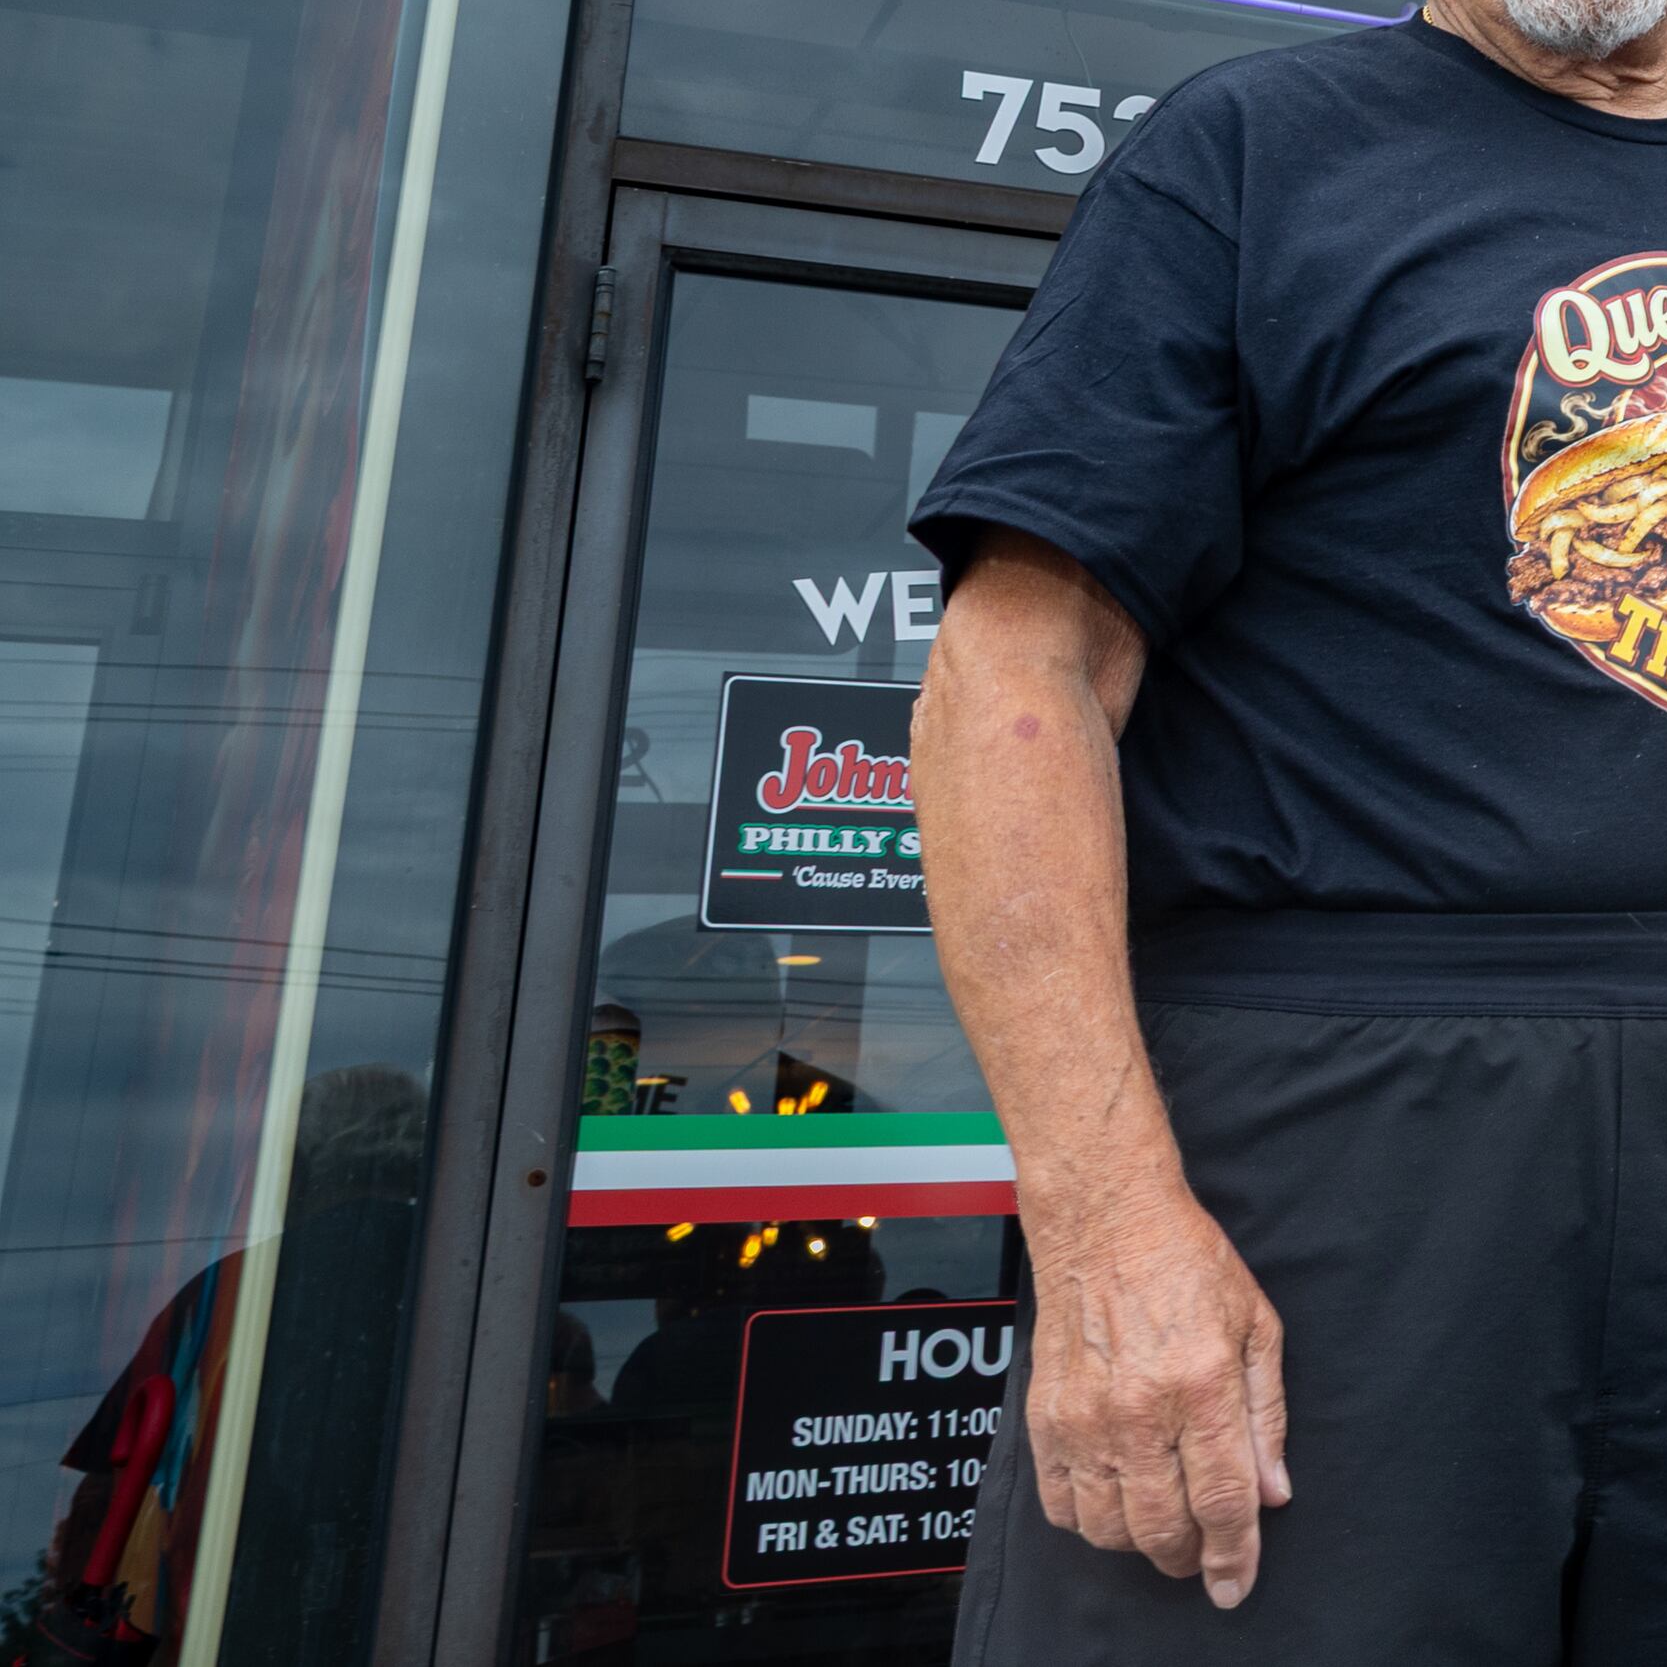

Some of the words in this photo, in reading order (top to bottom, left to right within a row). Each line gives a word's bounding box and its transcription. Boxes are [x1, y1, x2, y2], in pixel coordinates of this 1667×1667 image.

[740, 825, 892, 856] PHILLY
[868, 868, 928, 896] Ever
[792, 1411, 919, 1447] SUNDAY:
[746, 1461, 937, 1501] MON-THURS:
[758, 1521, 808, 1553] FRI
[814, 1519, 839, 1549] &
[846, 1514, 908, 1546] SAT:
